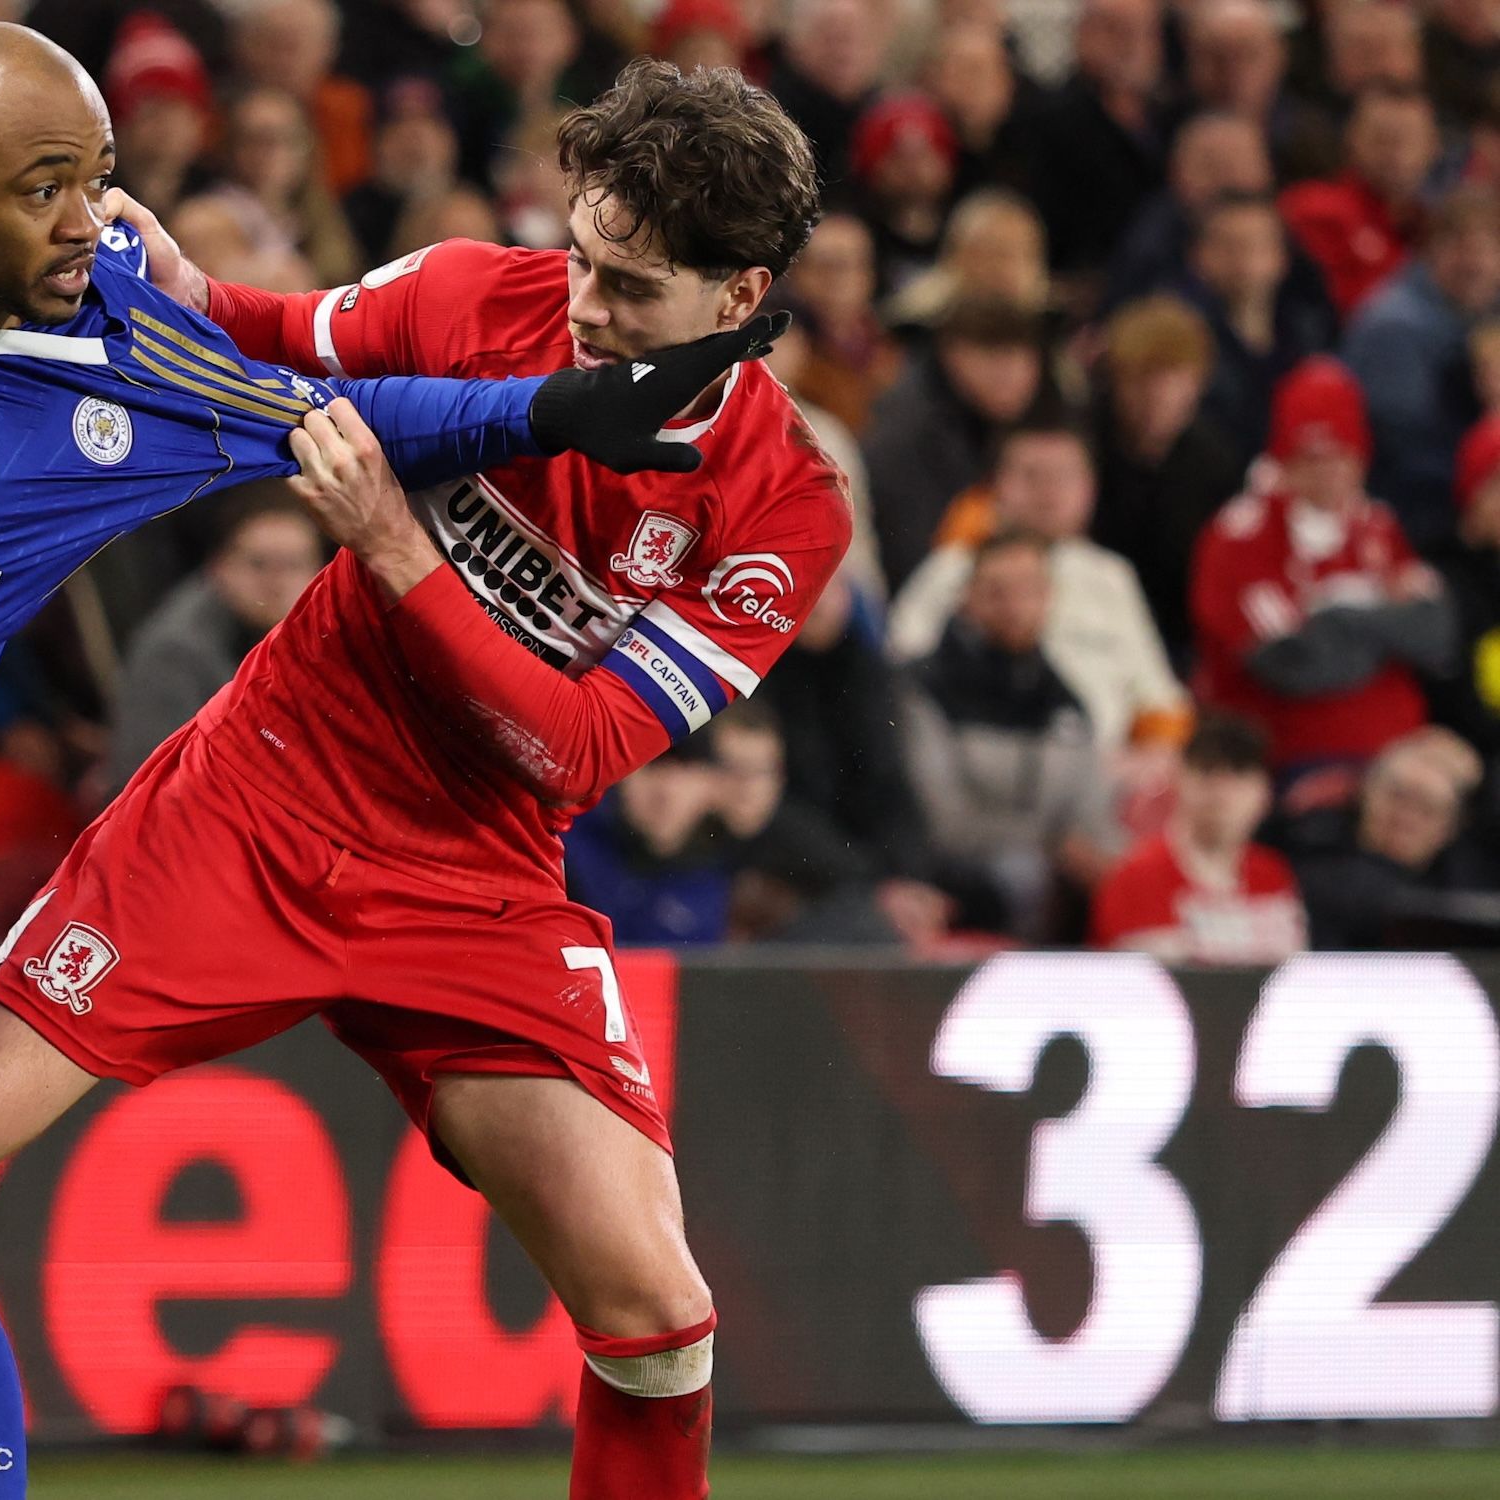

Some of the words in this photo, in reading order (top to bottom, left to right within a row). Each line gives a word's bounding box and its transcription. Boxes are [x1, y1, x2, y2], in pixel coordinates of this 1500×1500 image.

[448, 482, 607, 630] UNIBET
[484, 605, 547, 658] MISSION
[628, 640, 650, 661] EFL
[650, 658, 699, 713] CAPTAIN
[560, 946, 627, 1043] 7
[912, 950, 1500, 1424] 32
